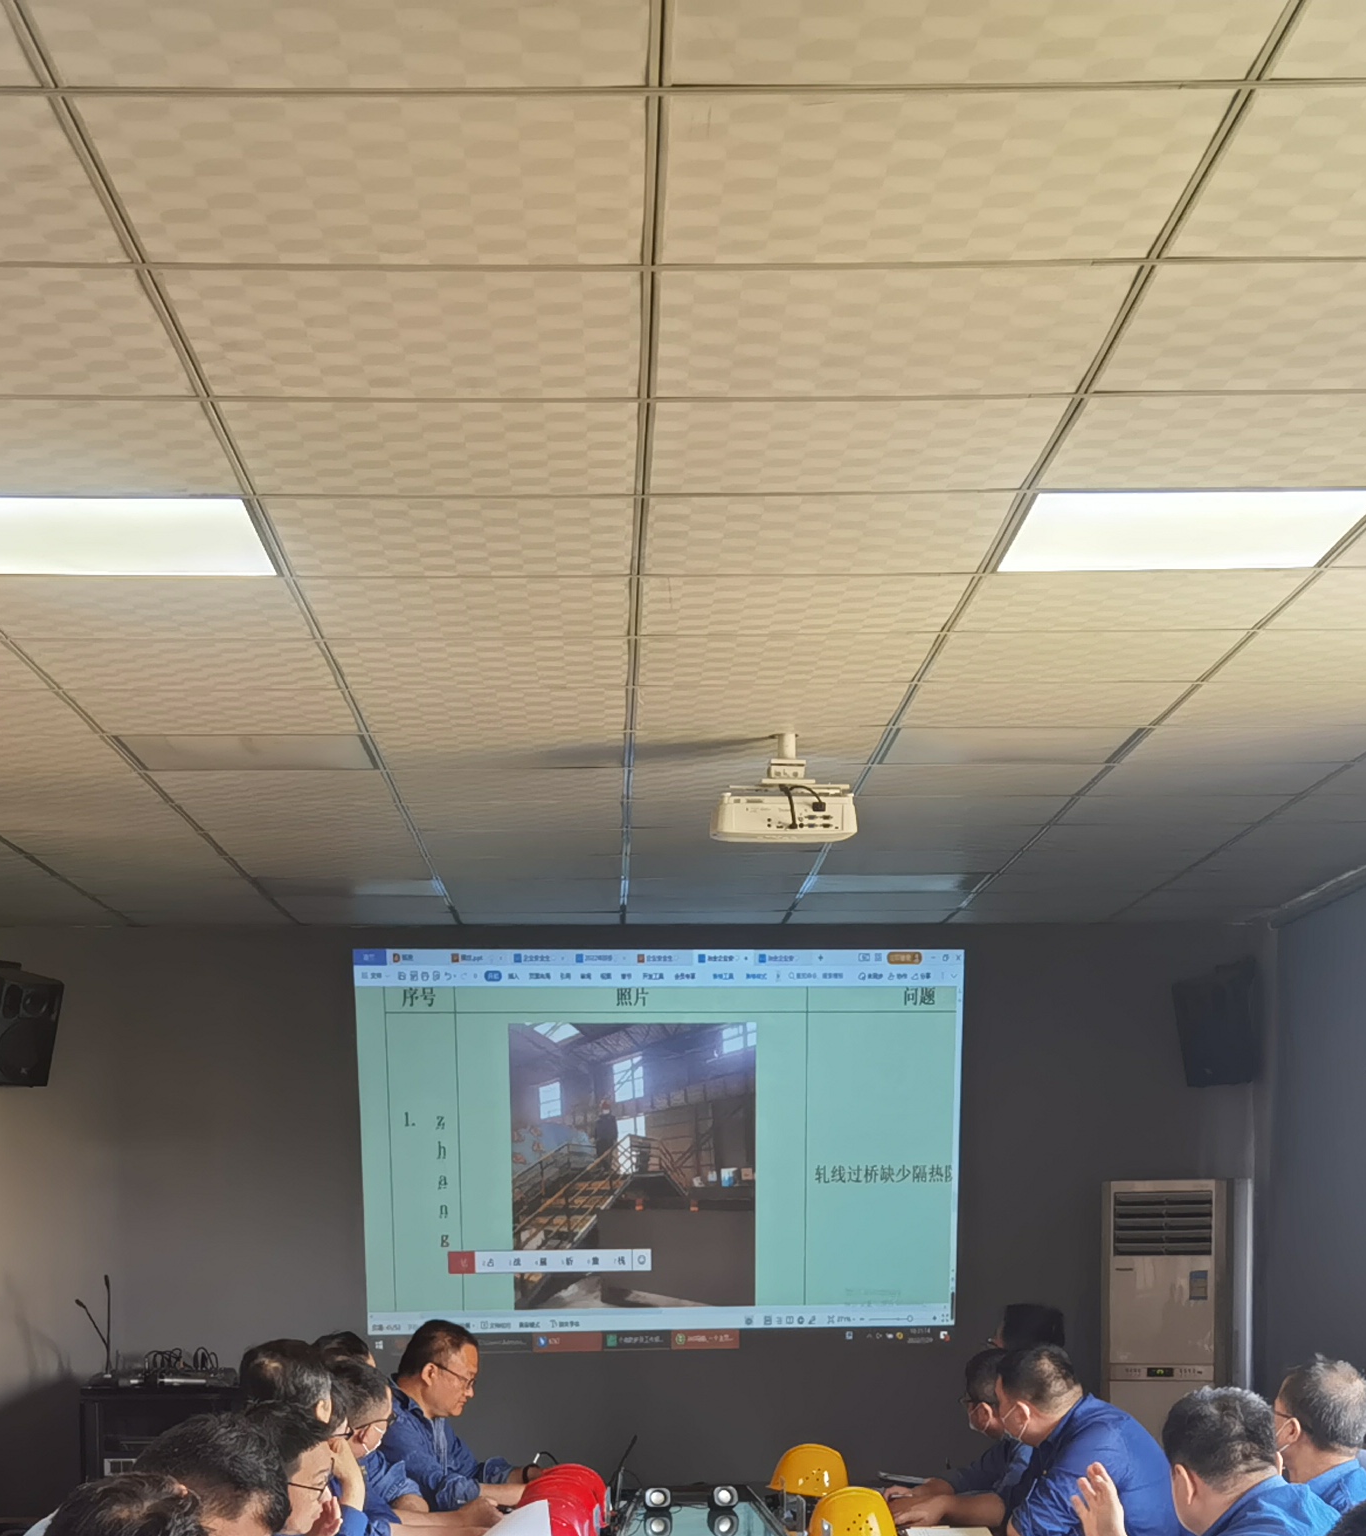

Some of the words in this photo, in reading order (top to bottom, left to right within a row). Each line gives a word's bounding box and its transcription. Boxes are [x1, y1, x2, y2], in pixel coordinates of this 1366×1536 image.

[402, 986, 436, 1007] 序号
[616, 987, 649, 1007] 照片
[903, 986, 935, 1006] 问题
